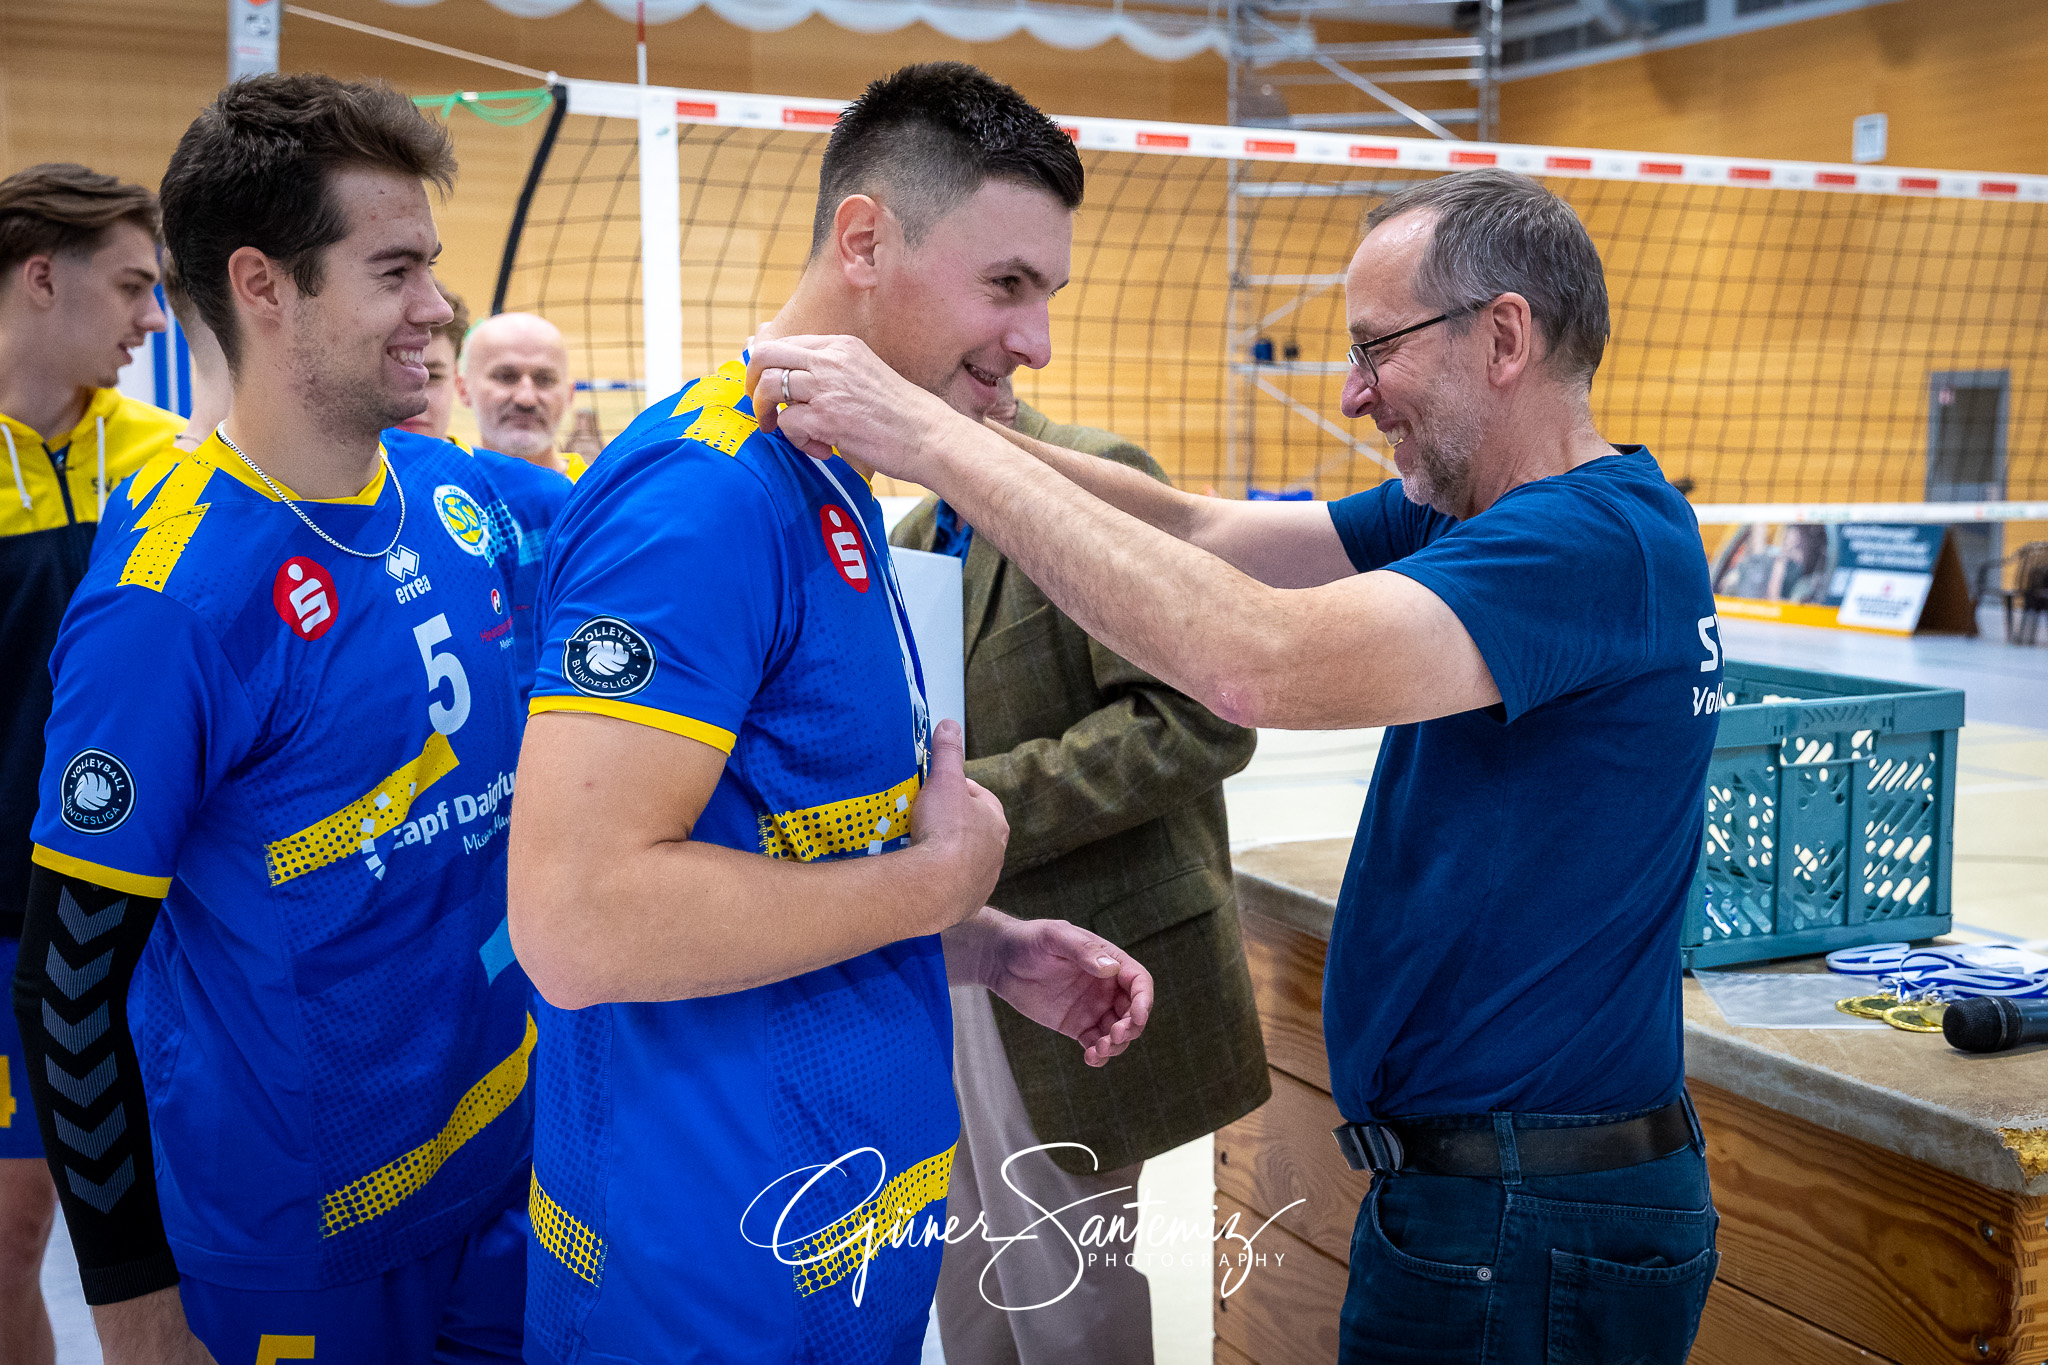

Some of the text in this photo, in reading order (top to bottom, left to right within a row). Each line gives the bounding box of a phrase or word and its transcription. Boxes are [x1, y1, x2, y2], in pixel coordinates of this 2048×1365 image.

[575, 626, 642, 657] OLLEYBAL
[1697, 613, 1725, 672] S
[412, 612, 471, 736] 5
[70, 758, 125, 792] VOLLEYBALL
[65, 795, 121, 825] BUNDESLIGA
[453, 771, 516, 824] Daigfu
